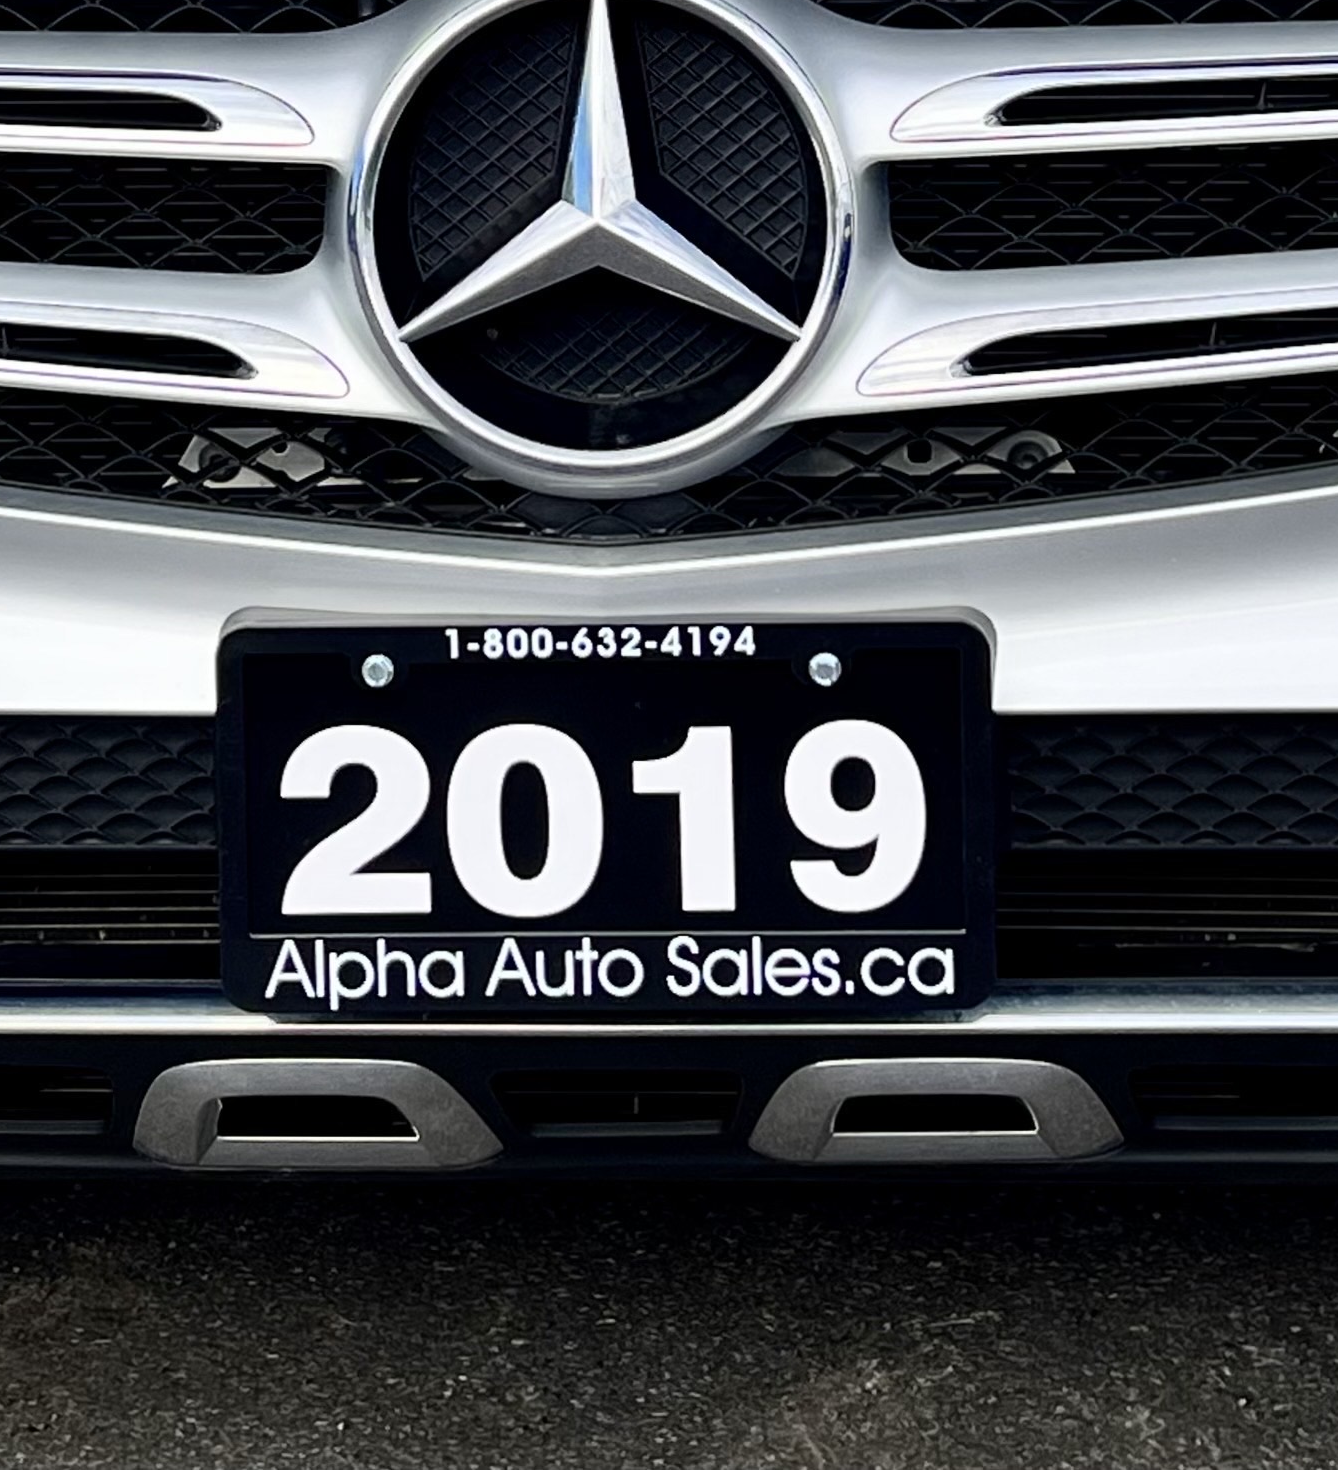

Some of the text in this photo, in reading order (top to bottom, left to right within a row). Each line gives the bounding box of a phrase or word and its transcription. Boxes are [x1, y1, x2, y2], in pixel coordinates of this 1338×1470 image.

[444, 625, 757, 660] 1-800-632-4194
[279, 719, 928, 918] 2019
[264, 935, 955, 1011] Alpha Auto Sales.ca
